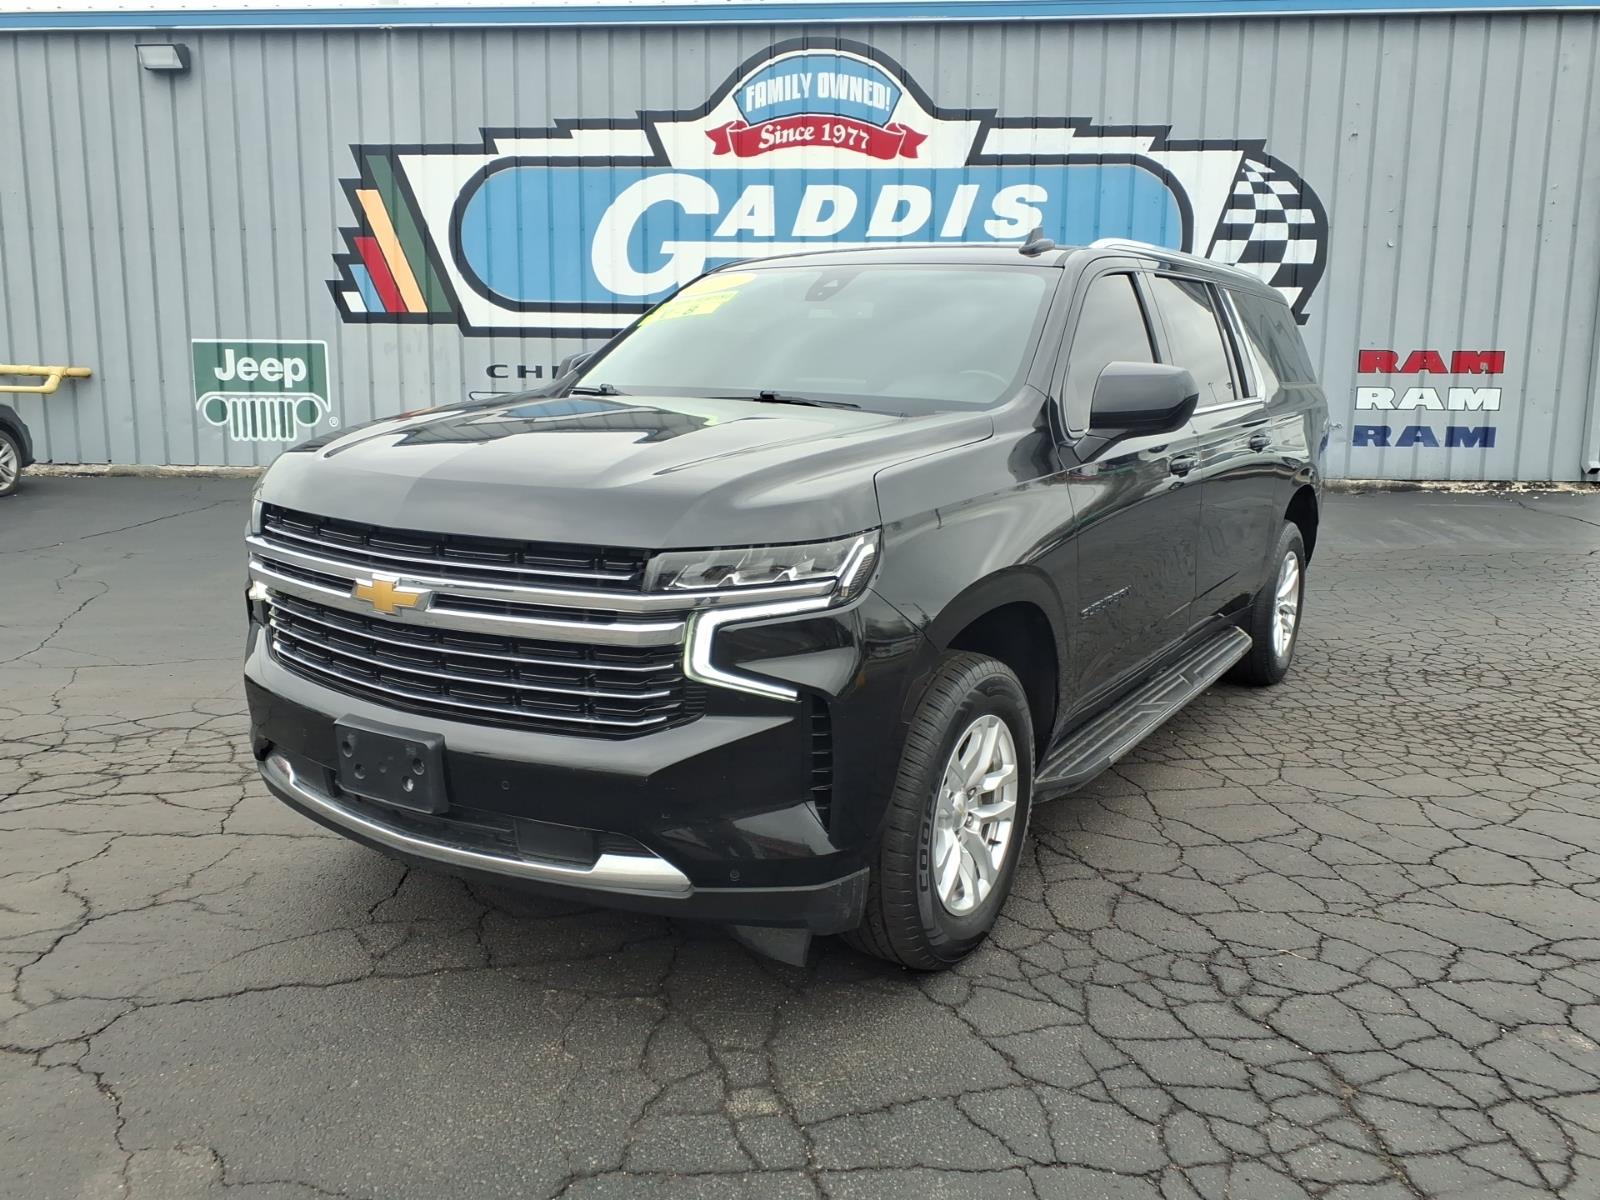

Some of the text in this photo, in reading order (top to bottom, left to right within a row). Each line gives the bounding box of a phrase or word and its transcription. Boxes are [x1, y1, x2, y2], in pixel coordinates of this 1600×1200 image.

[746, 72, 891, 112] FAMILY OWNED!
[758, 123, 870, 150] Since 1977
[591, 172, 1048, 297] GADDIS
[214, 348, 307, 388] Jeep
[1357, 349, 1506, 374] RAM
[1354, 386, 1503, 411] RAM
[1352, 425, 1497, 448] RAM
